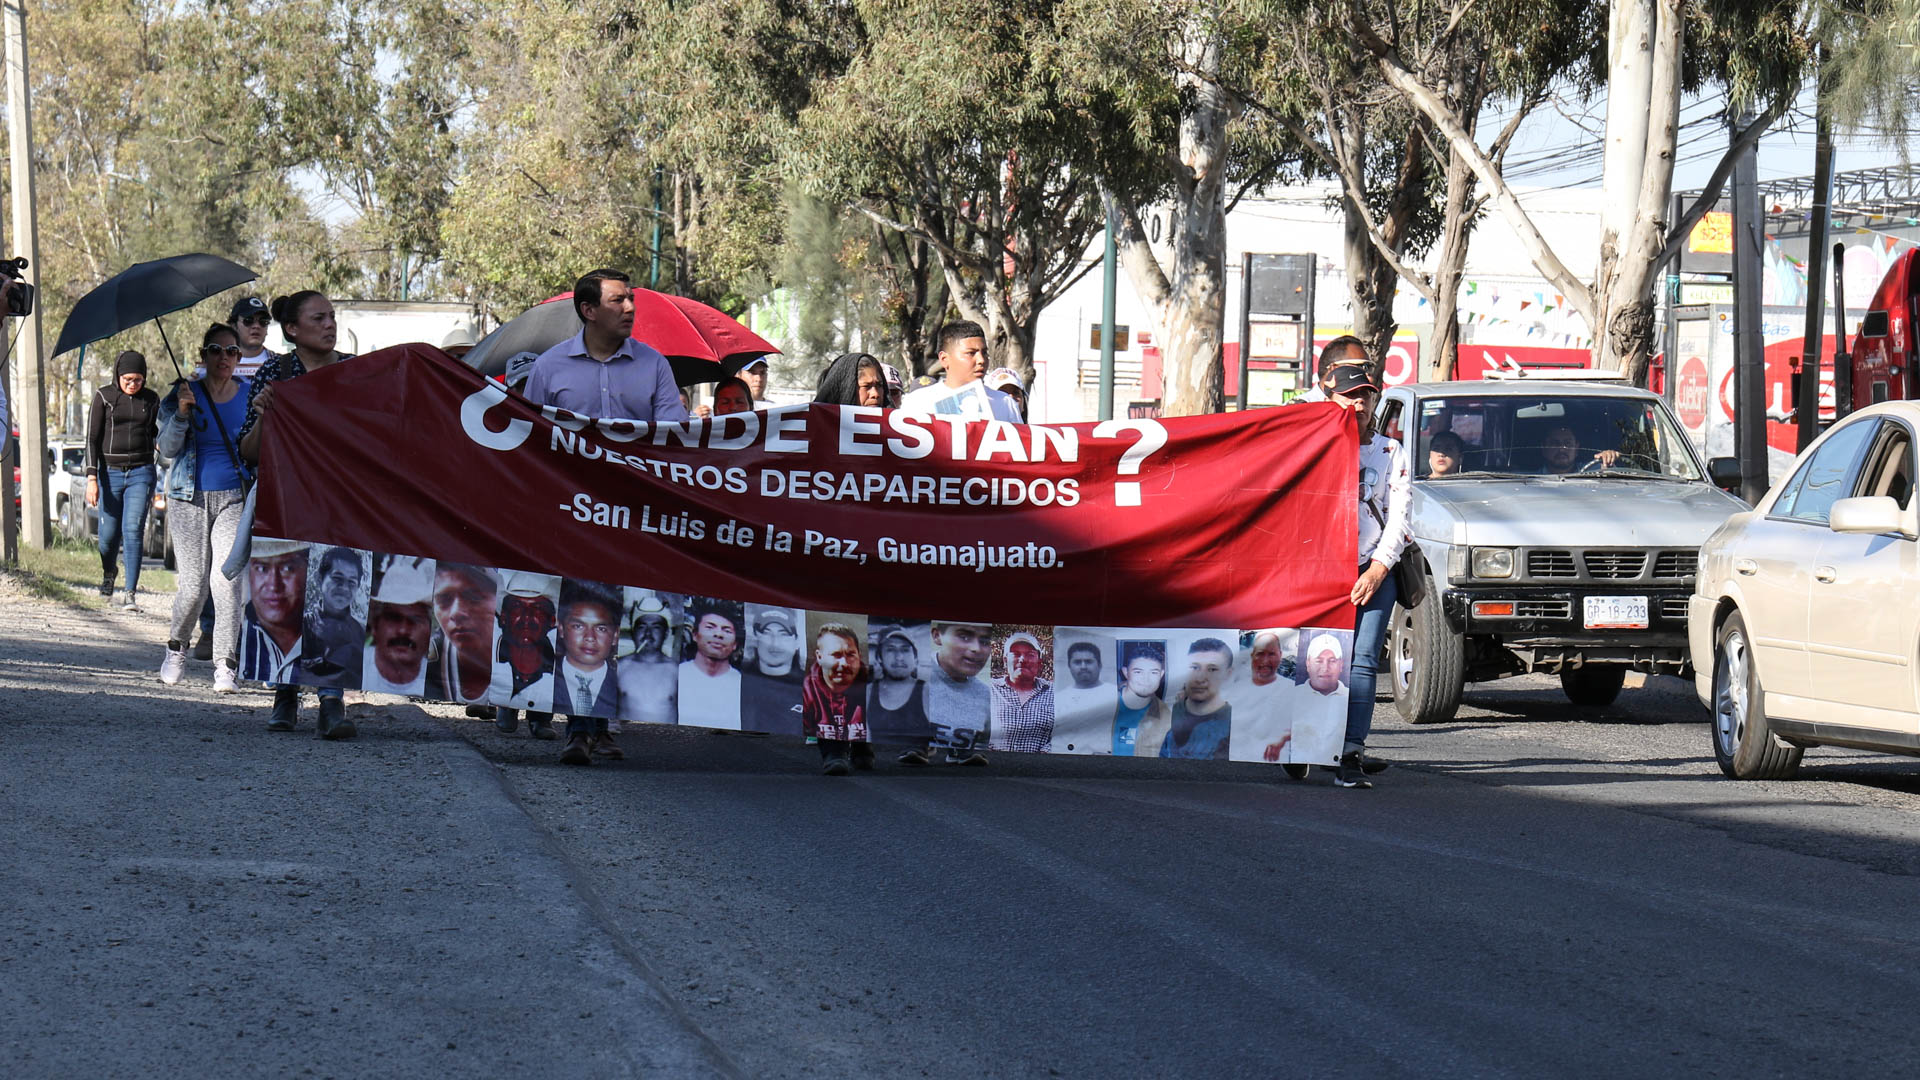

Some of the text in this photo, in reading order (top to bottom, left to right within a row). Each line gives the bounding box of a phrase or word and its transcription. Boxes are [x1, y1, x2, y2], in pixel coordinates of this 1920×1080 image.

[550, 425, 1081, 507] NUESTROS DESAPARECIDOS
[640, 505, 706, 541] Luis
[716, 519, 755, 548] de
[764, 524, 793, 553] la
[804, 529, 868, 566] Paz,
[877, 536, 1065, 573] Guanajuato.
